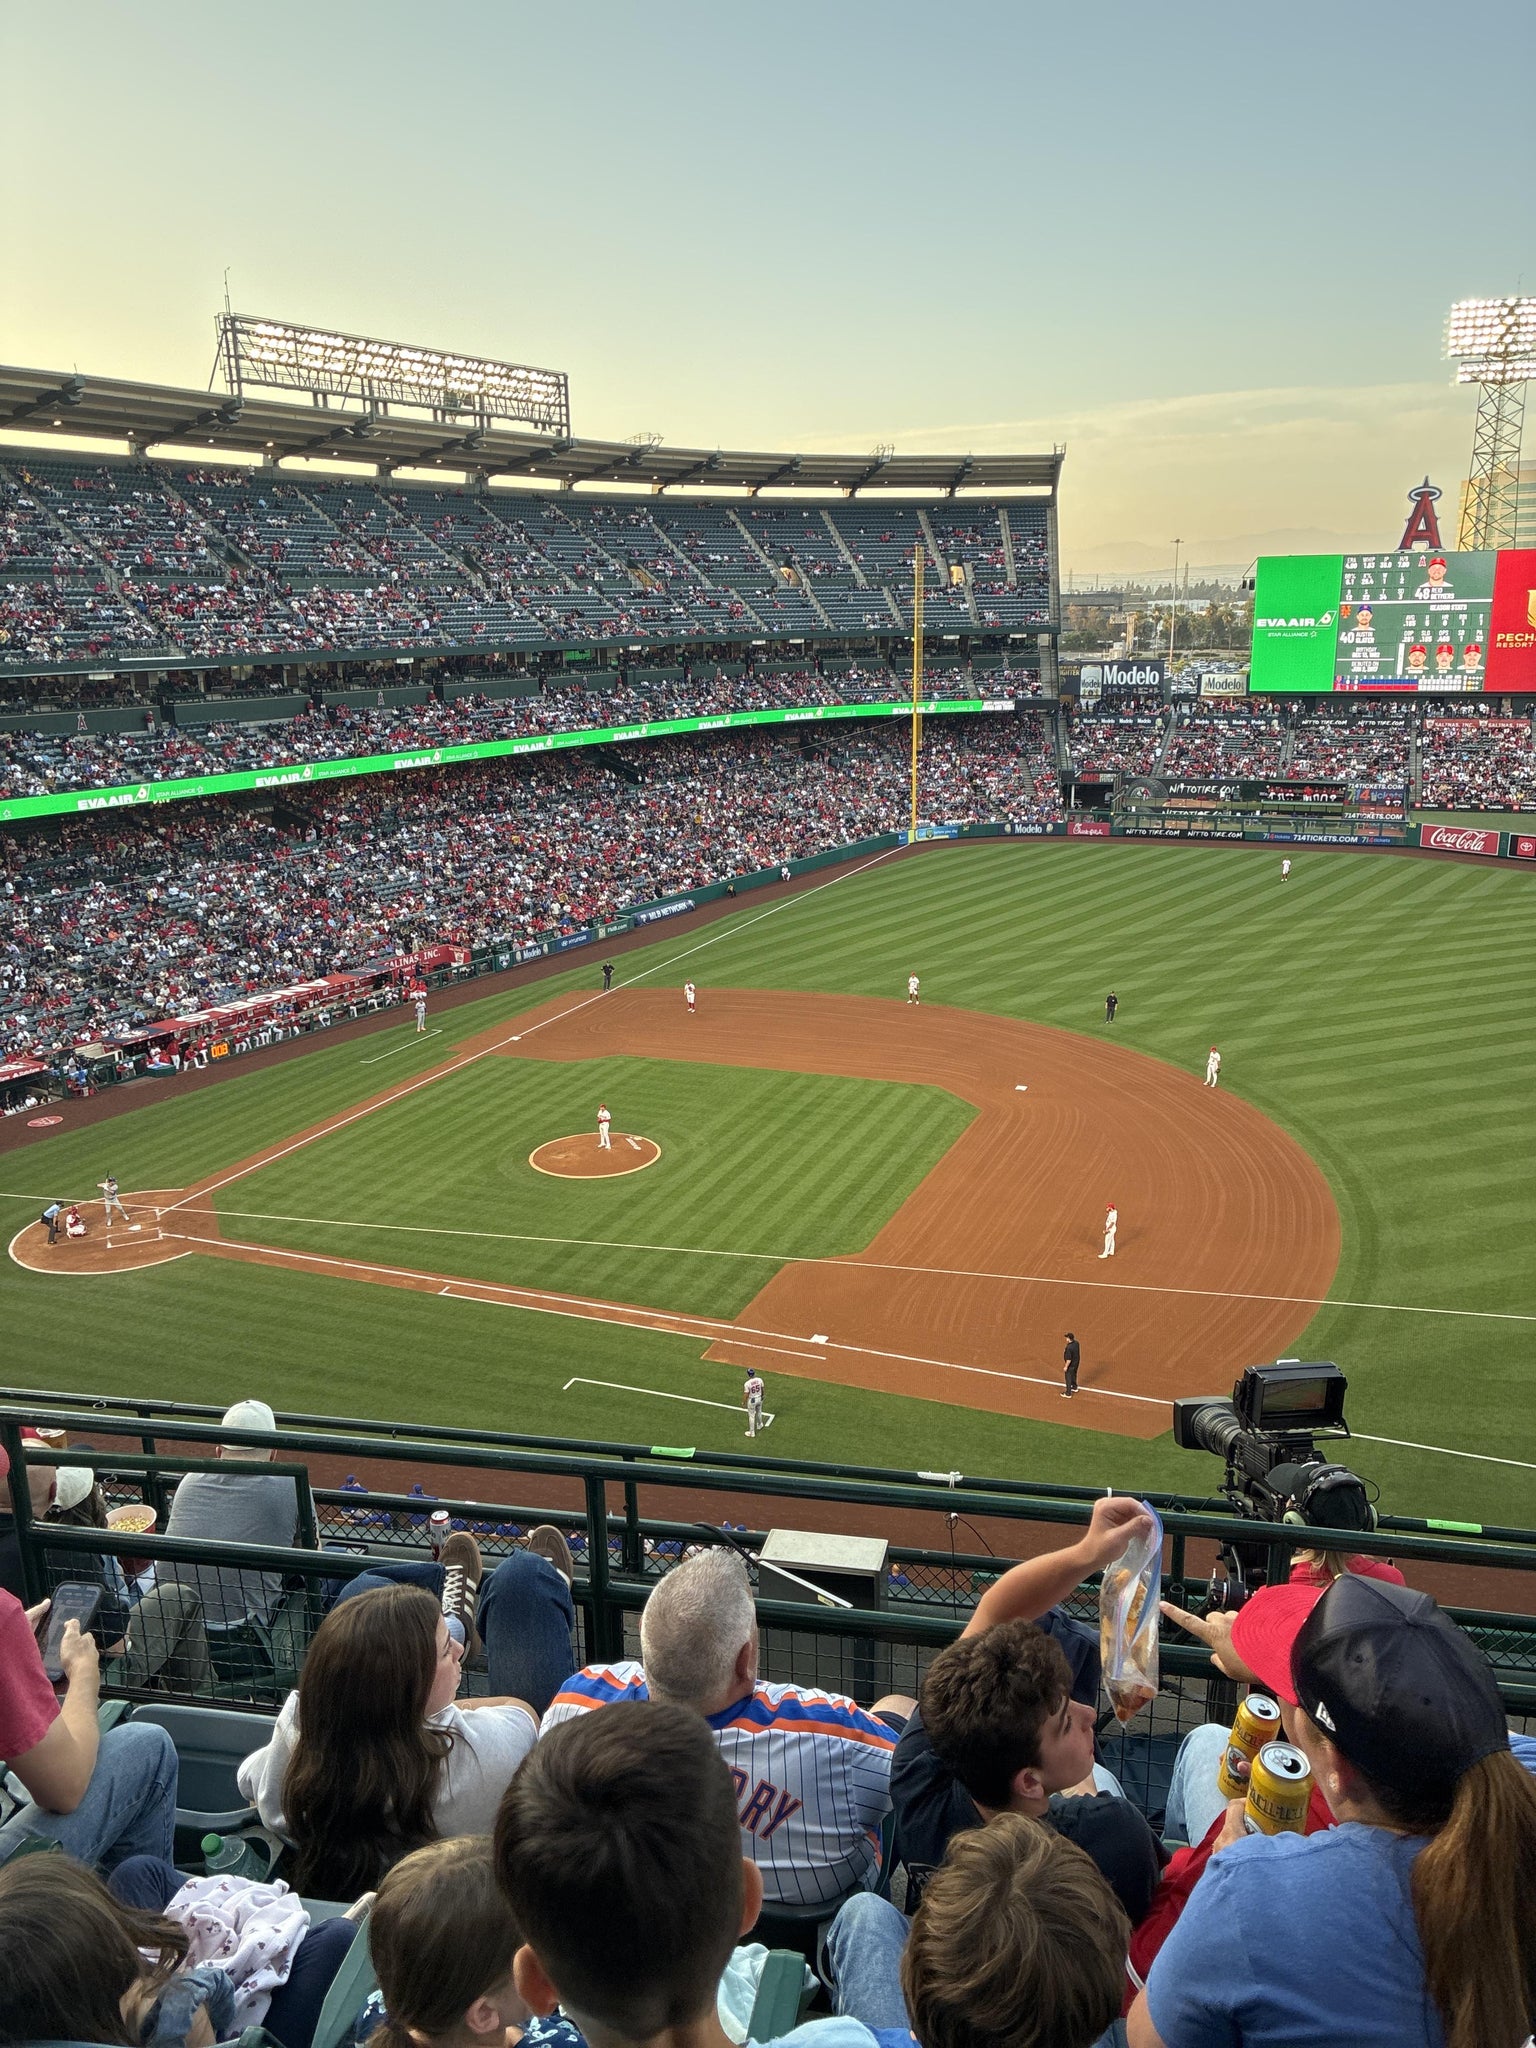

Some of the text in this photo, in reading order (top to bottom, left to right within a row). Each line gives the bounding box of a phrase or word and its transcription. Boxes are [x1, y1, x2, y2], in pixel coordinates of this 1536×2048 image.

[1414, 588, 1430, 600] 48
[1339, 631, 1355, 643] 40
[1497, 633, 1536, 641] PECH
[1103, 664, 1160, 685] Modelo
[1208, 676, 1241, 691] Modelo
[1014, 823, 1043, 834] Modelo
[1148, 829, 1181, 837] TIRE.COM
[1210, 831, 1243, 839] TIRE.COM
[1293, 835, 1358, 843] 714TICKETS.COM
[1430, 827, 1489, 851] Coca-Cola
[648, 902, 688, 920] MLB NETWORK
[423, 948, 441, 960] INC.
[523, 947, 541, 960] Modelo
[175, 978, 331, 1023] ANGELS
[751, 1384, 760, 1394] 65
